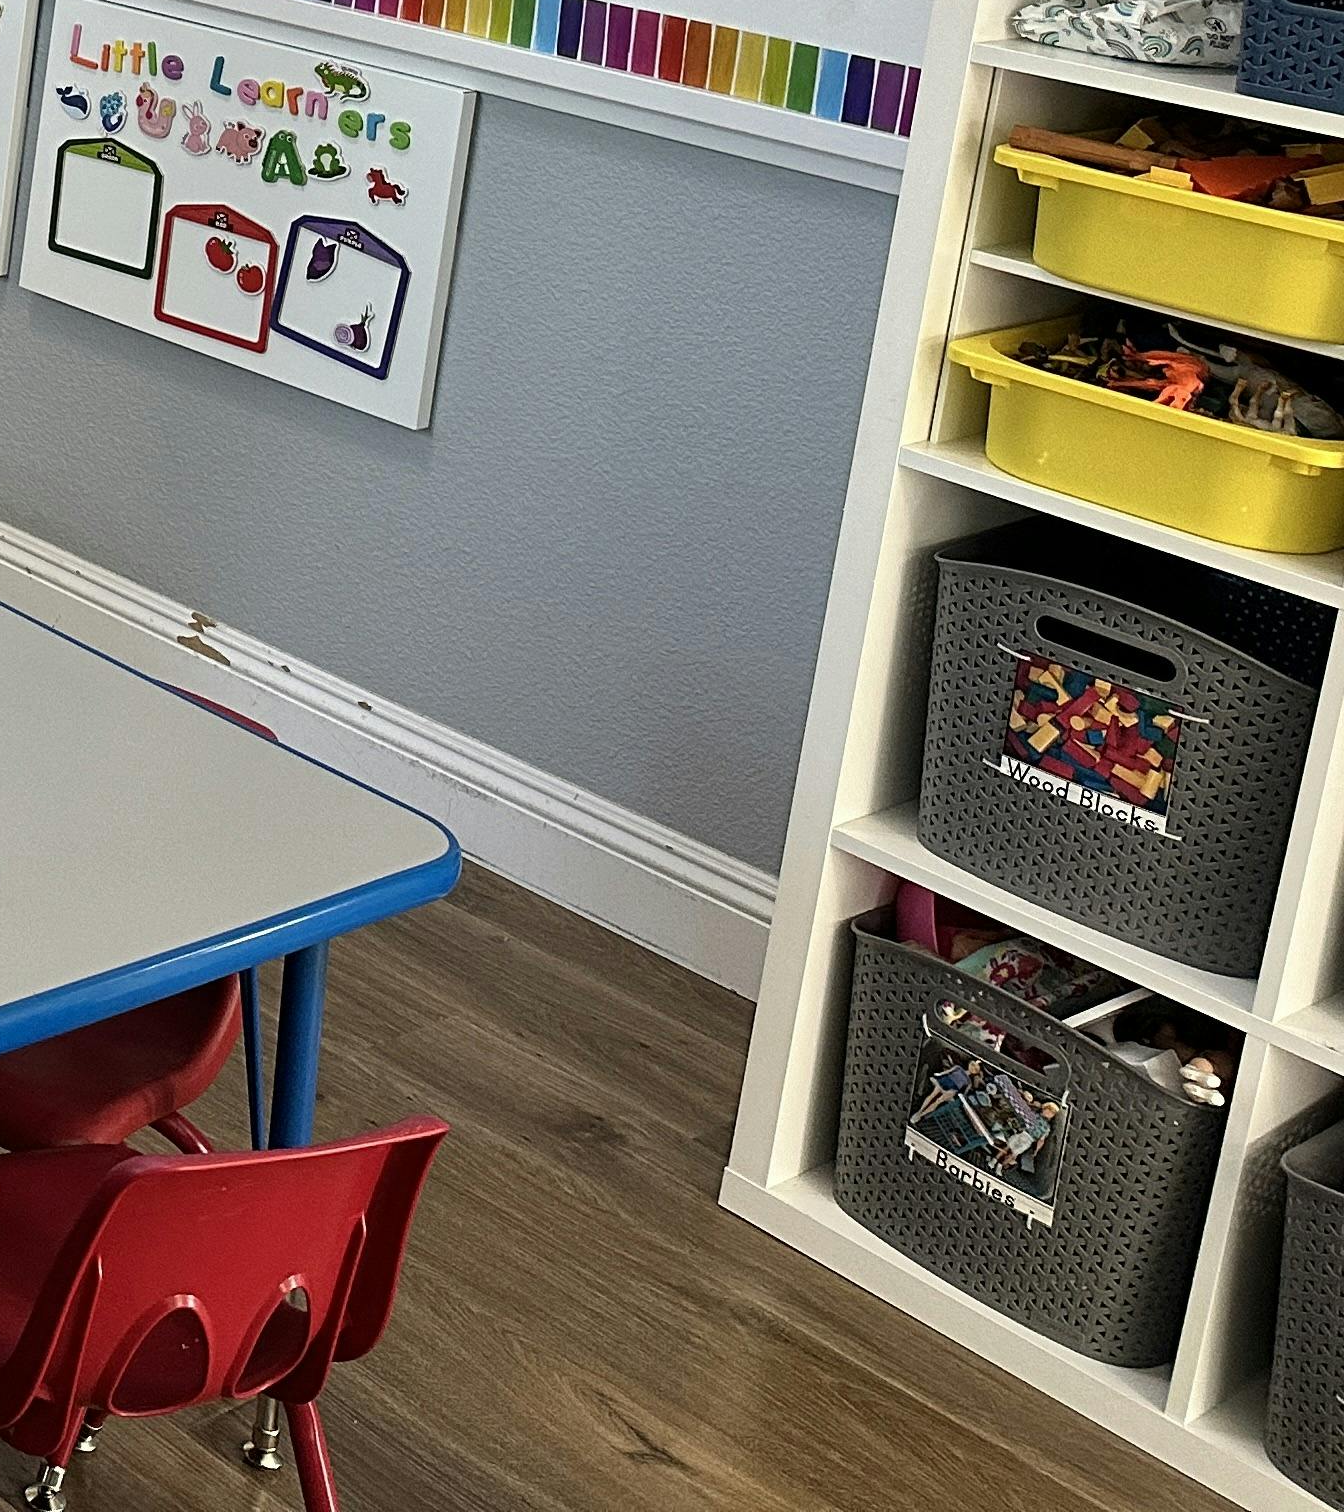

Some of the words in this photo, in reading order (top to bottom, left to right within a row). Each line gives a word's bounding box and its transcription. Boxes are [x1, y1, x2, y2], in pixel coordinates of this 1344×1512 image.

[70, 23, 185, 81] Little
[210, 54, 412, 151] Learners
[1007, 757, 1070, 801] Wood
[1079, 788, 1159, 833] Blocks
[935, 1148, 1016, 1208] Barbies
